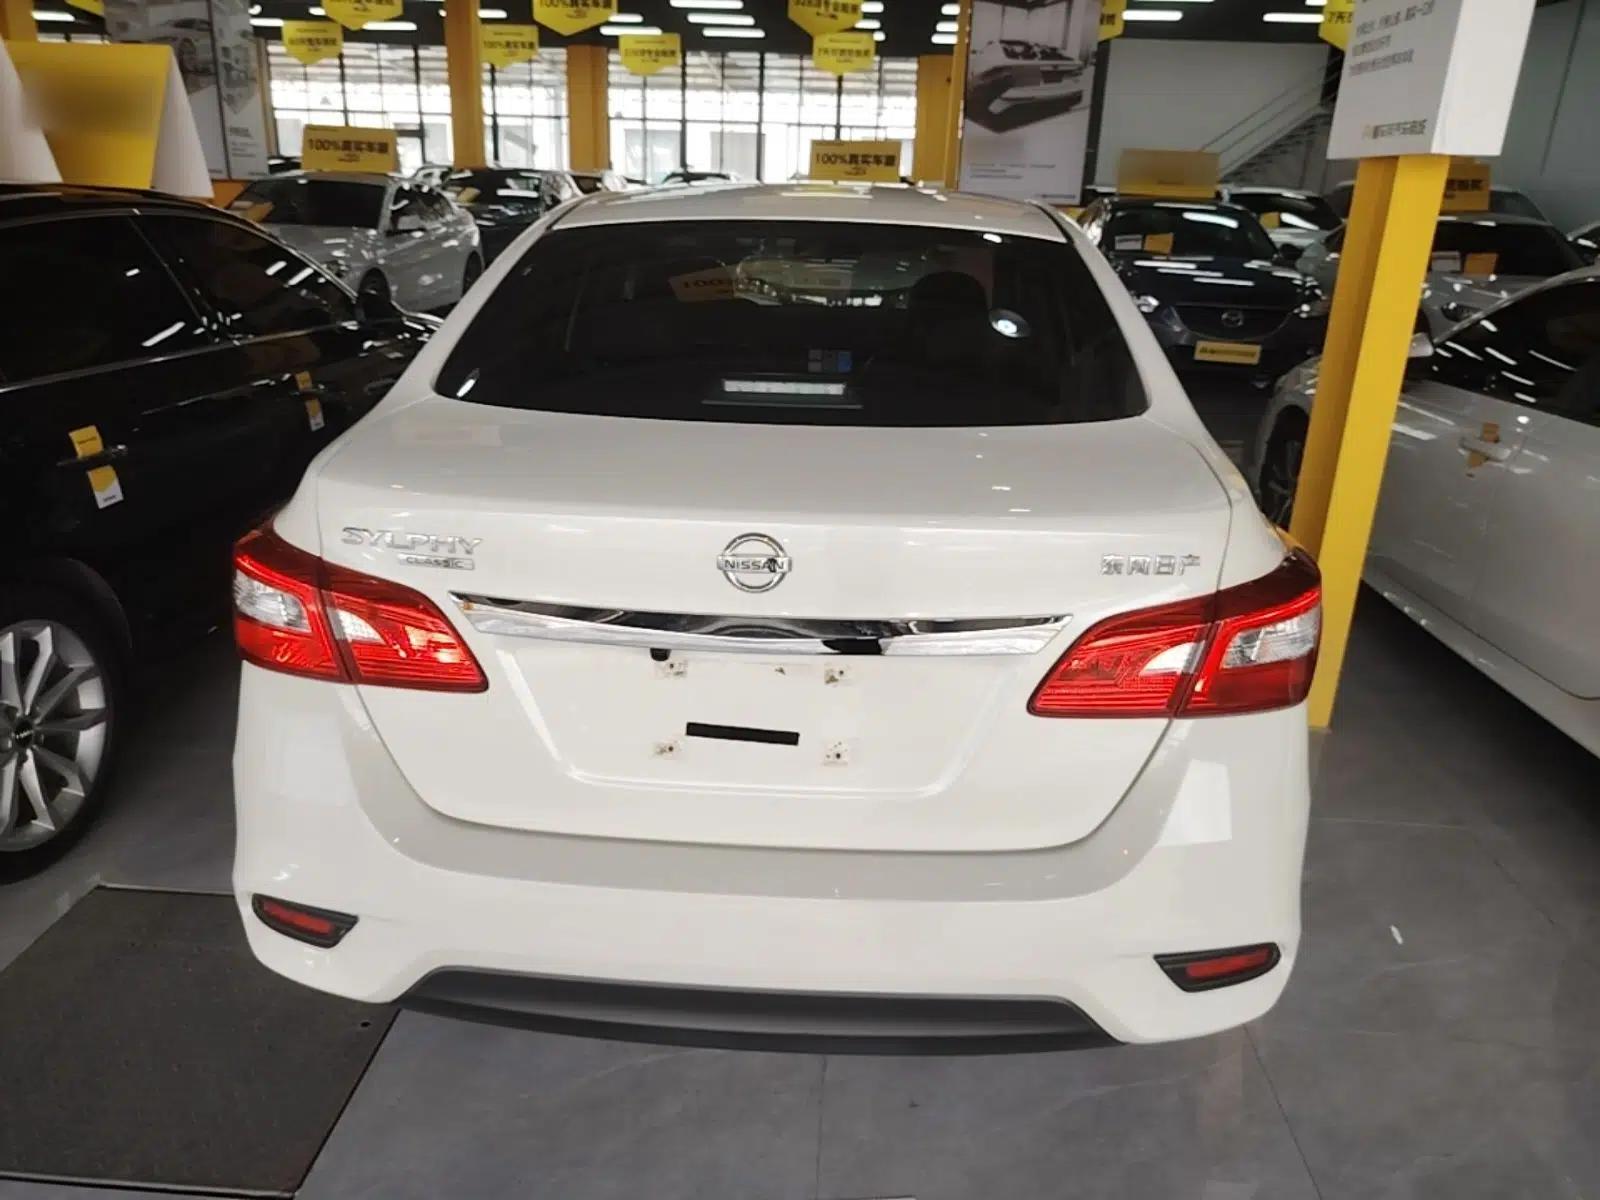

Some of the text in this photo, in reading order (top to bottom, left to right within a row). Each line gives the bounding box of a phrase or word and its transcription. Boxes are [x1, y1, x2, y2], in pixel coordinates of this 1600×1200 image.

[341, 527, 483, 555] SYLPHY
[406, 556, 465, 569] CLASSIC
[725, 559, 784, 571] NISSAN
[1101, 554, 1199, 576] 东风日产
